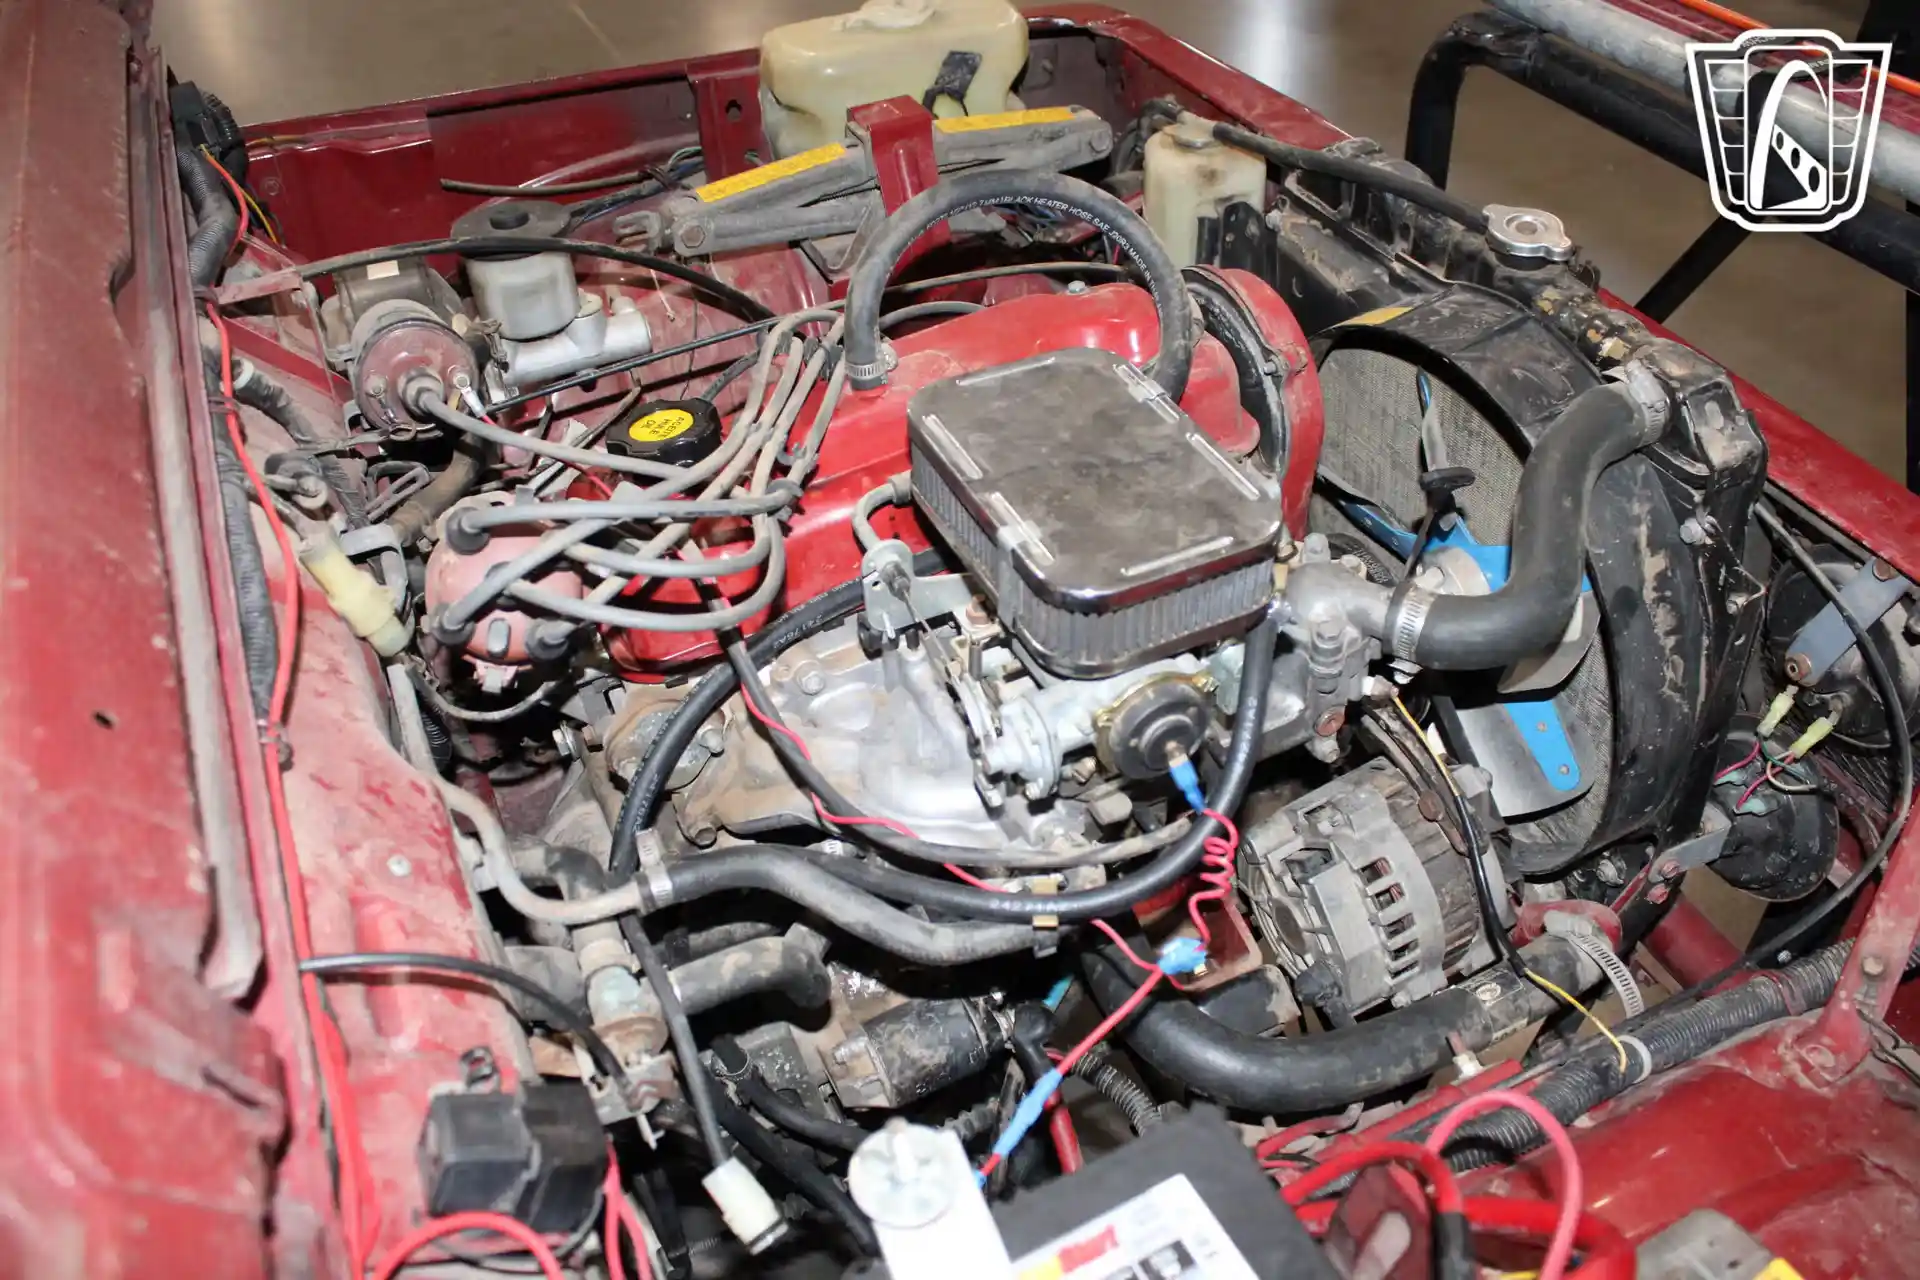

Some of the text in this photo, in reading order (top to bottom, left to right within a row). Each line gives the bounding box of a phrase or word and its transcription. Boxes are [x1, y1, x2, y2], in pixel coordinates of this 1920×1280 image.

[1033, 197, 1069, 211] HEATER
[1068, 206, 1094, 222] HOSE
[1092, 217, 1111, 233] SAE
[1128, 247, 1147, 271] MADE
[1143, 269, 1153, 281] IN
